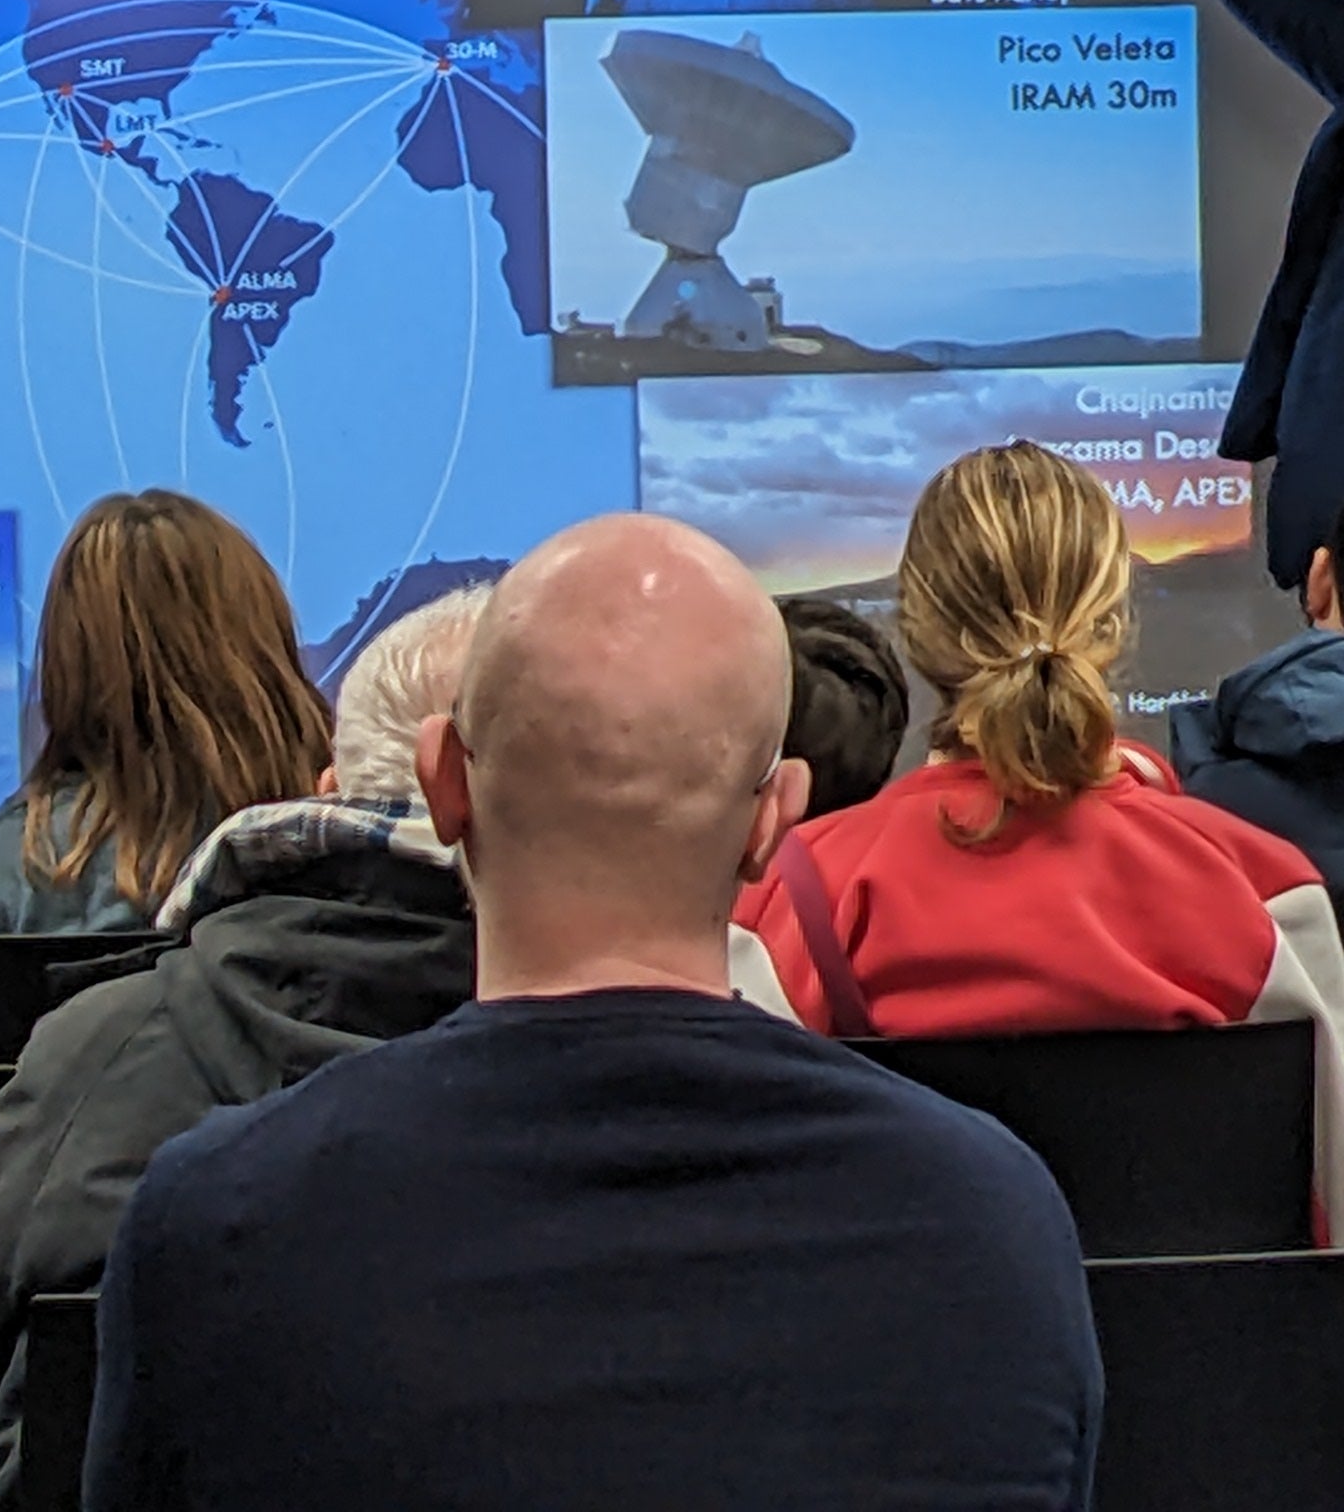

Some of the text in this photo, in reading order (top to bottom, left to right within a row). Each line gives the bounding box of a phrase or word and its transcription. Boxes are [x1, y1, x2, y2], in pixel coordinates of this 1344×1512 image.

[998, 33, 1177, 64] Pico Veleta
[80, 58, 126, 78] SMT
[1011, 80, 1178, 111] IRAM 30m
[115, 114, 157, 133] LMT
[236, 271, 297, 289] ALMA
[222, 302, 279, 320] APEX
[1075, 386, 1233, 420] Chajnanto
[1155, 430, 1218, 461] Des
[1172, 476, 1252, 507] APEX
